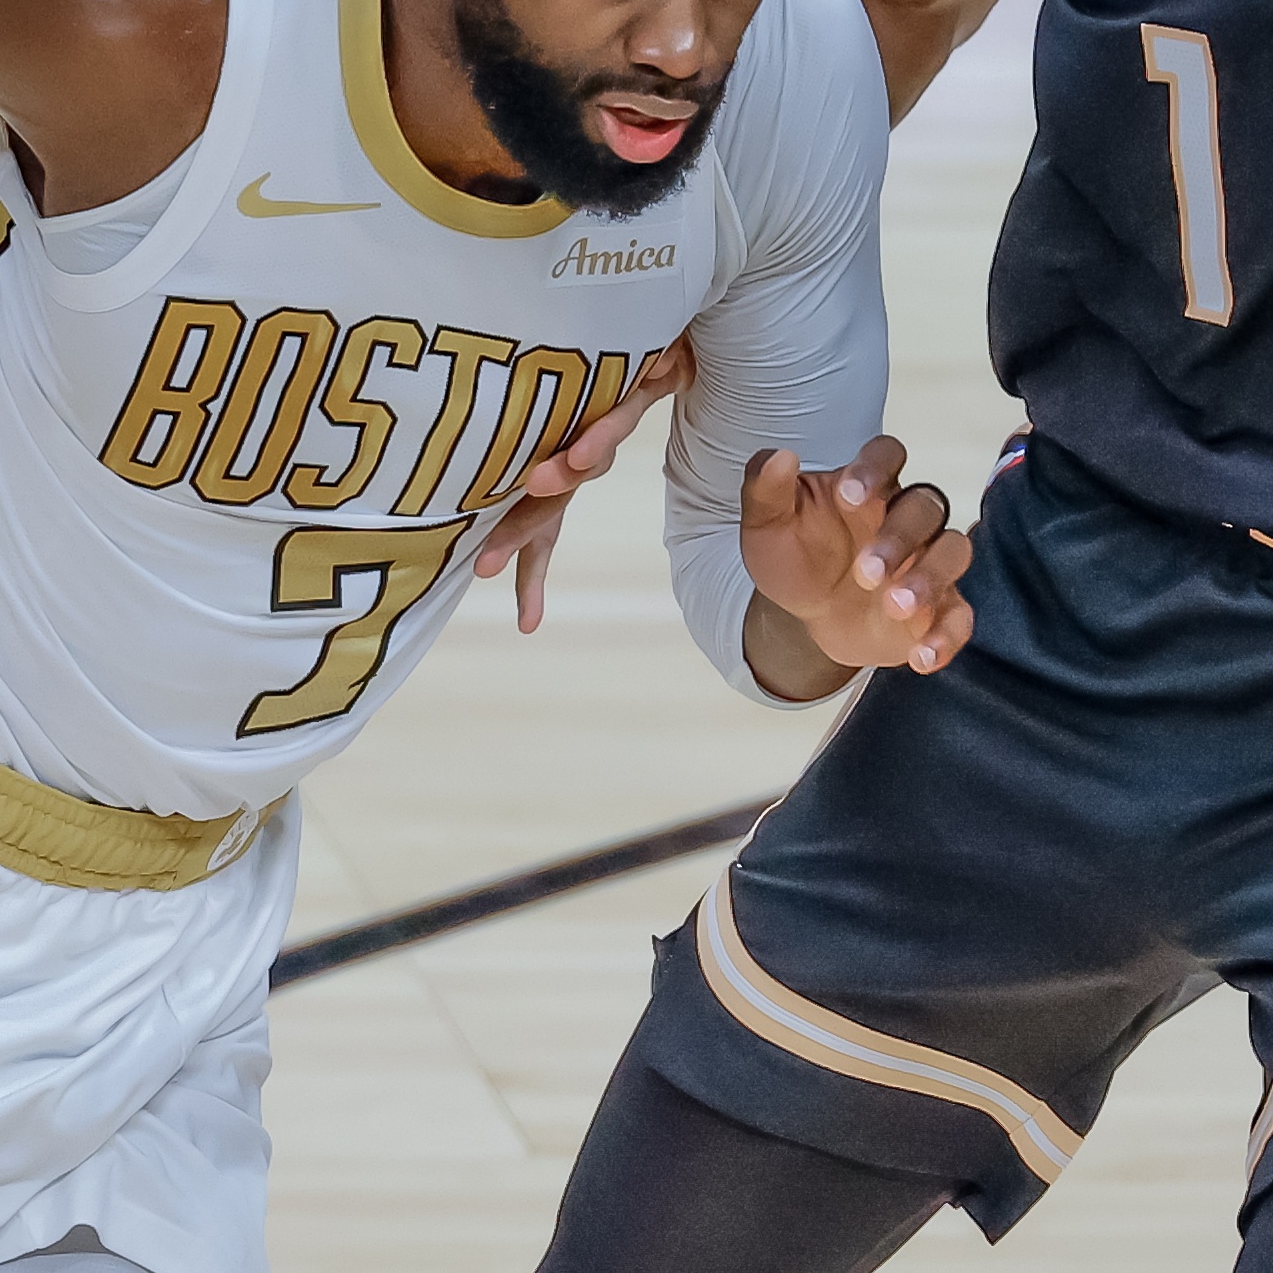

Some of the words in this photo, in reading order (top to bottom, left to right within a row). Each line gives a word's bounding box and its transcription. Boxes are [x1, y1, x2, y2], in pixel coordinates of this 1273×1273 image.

[551, 237, 676, 279] Amica
[1140, 23, 1234, 328] 1
[235, 512, 476, 740] 7
